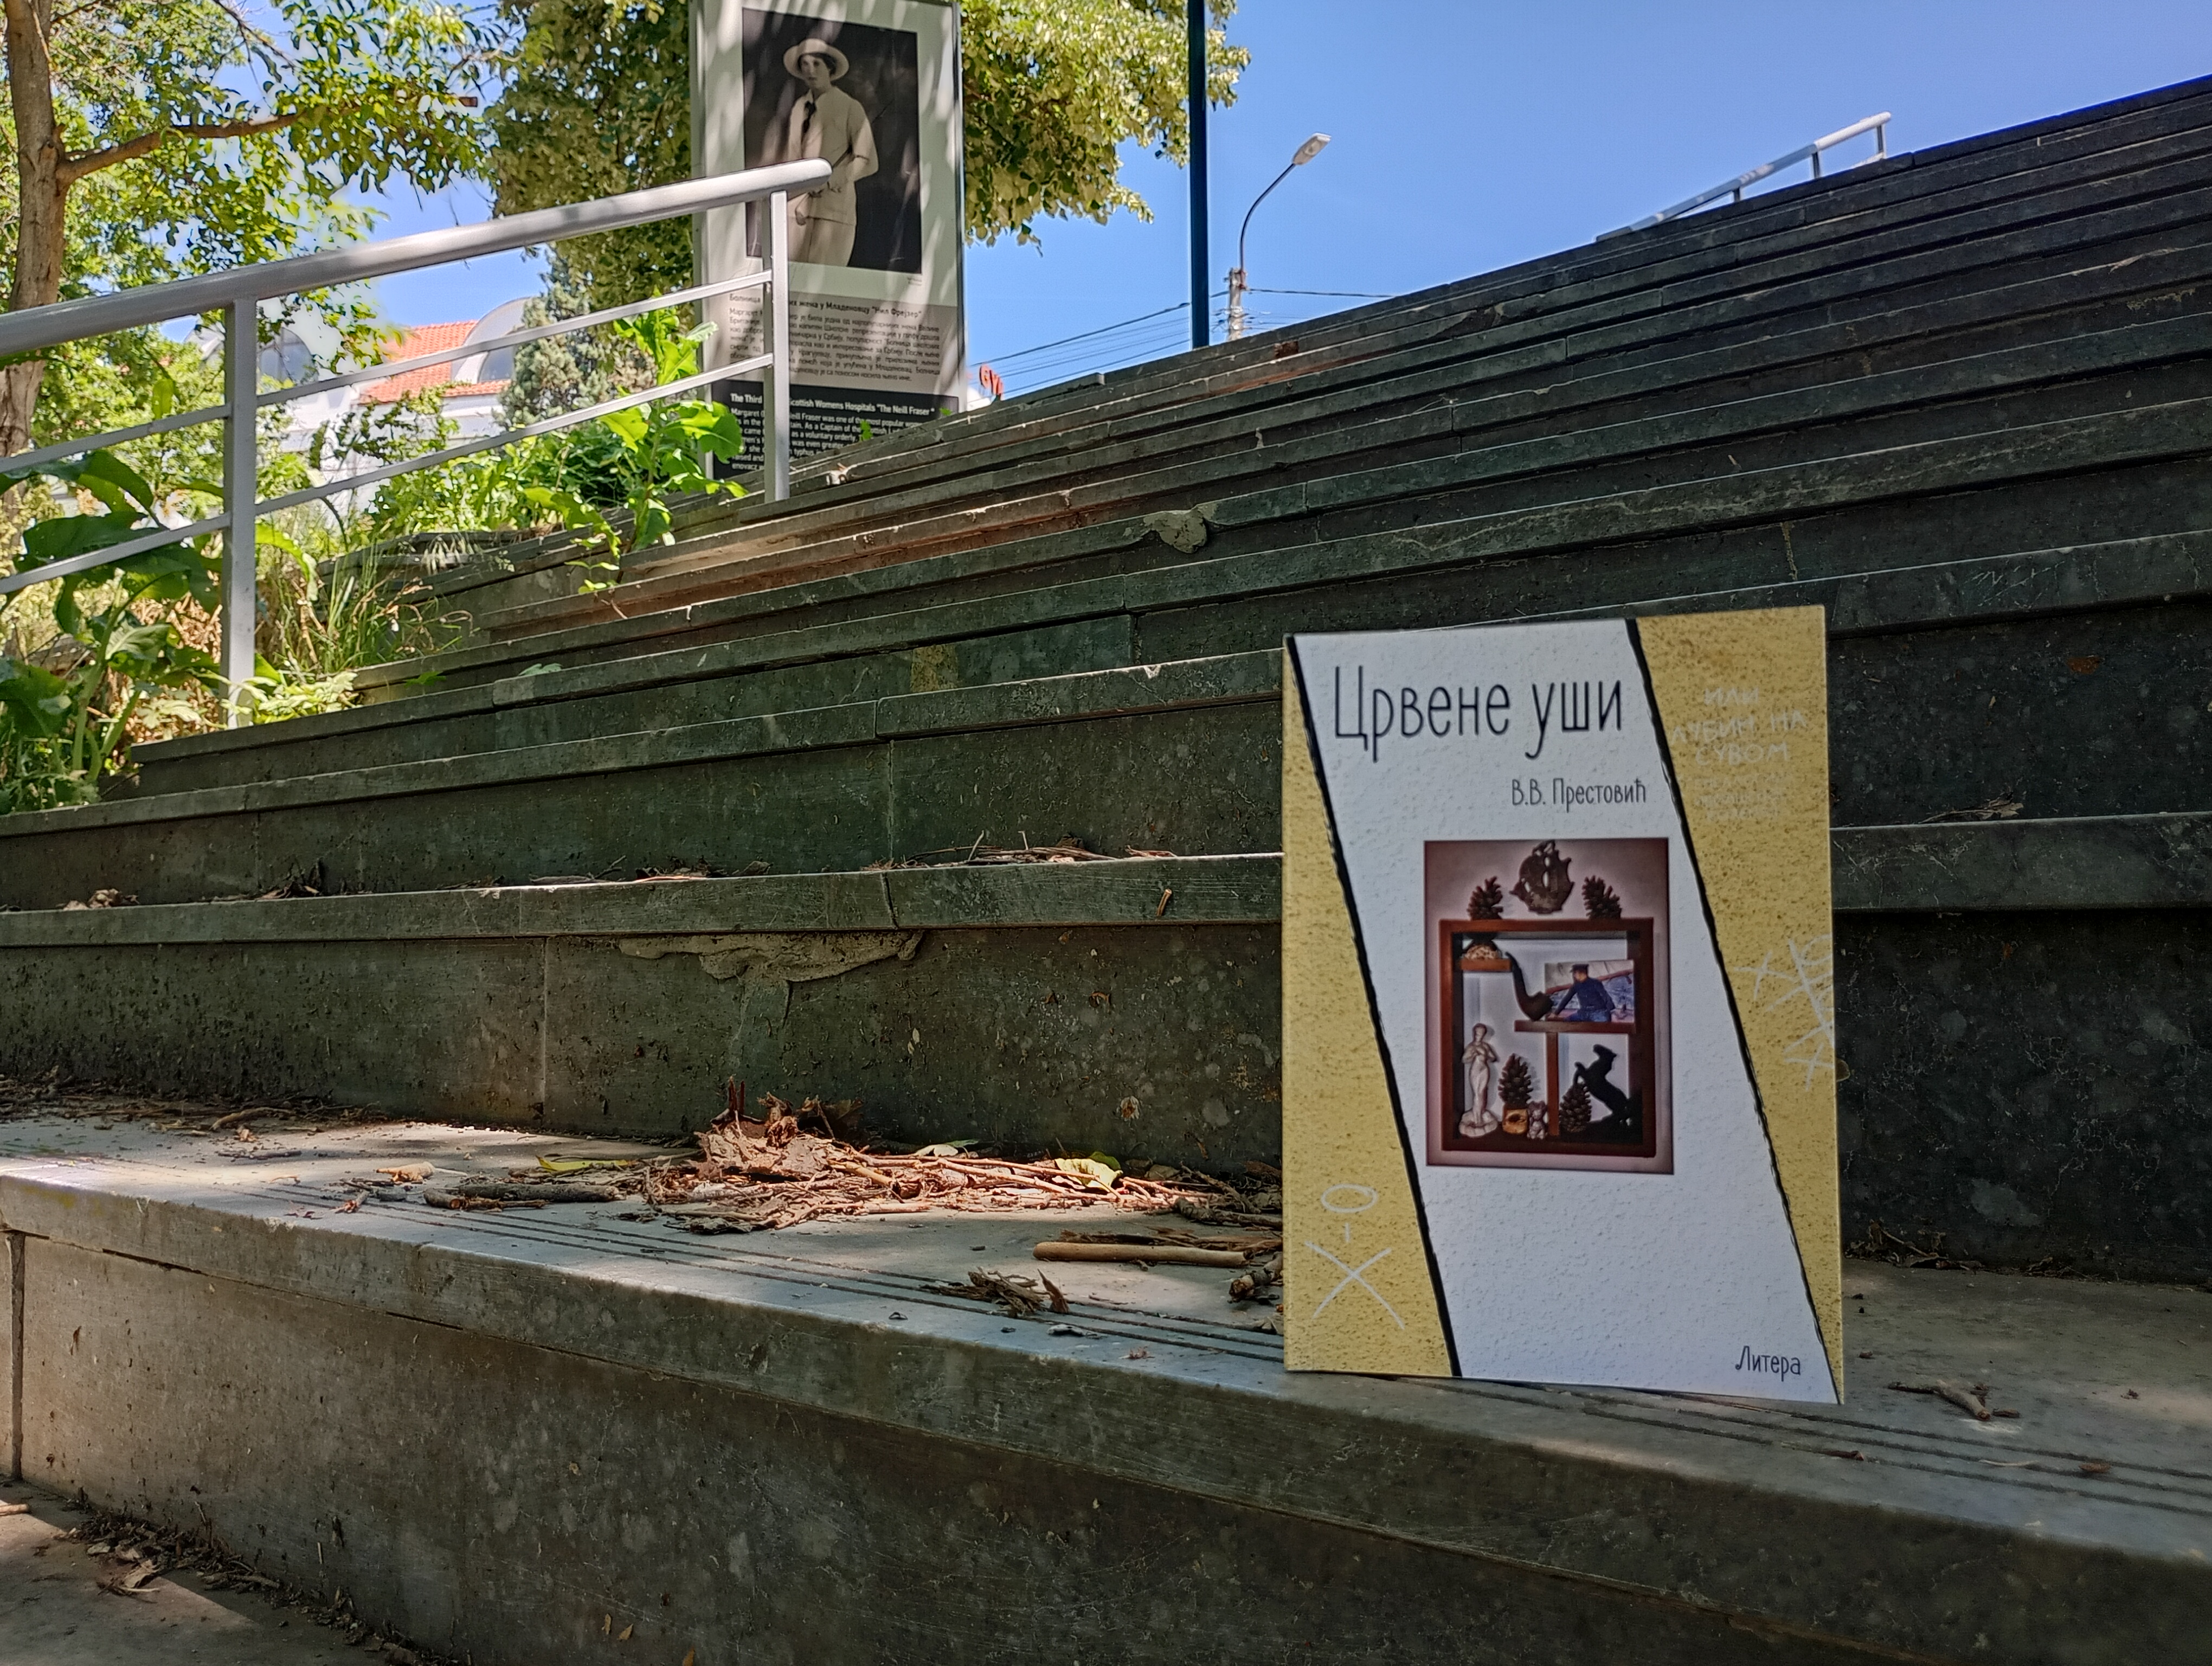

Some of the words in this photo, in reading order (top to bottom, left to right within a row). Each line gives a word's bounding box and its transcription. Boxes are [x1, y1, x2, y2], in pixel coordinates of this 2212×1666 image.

[730, 393, 744, 402] The
[744, 394, 763, 404] Third
[815, 399, 844, 409] Womens
[845, 401, 876, 413] Hospitals
[892, 405, 908, 414] Neill
[731, 407, 760, 417] Margaret
[801, 412, 821, 422] Fraser
[882, 419, 904, 428] popular
[805, 421, 813, 430] As
[820, 422, 843, 432] Captain
[844, 424, 851, 432] of
[851, 425, 861, 433] the
[805, 431, 833, 441] voluntary
[1334, 665, 1510, 762] Црвене
[1525, 679, 1622, 759] уши
[1770, 709, 1807, 733] НА
[1695, 741, 1789, 766] СУВОМ
[1512, 778, 1546, 806] В.В.
[1552, 777, 1647, 813] Престовић
[1734, 1345, 1802, 1382] Литера
